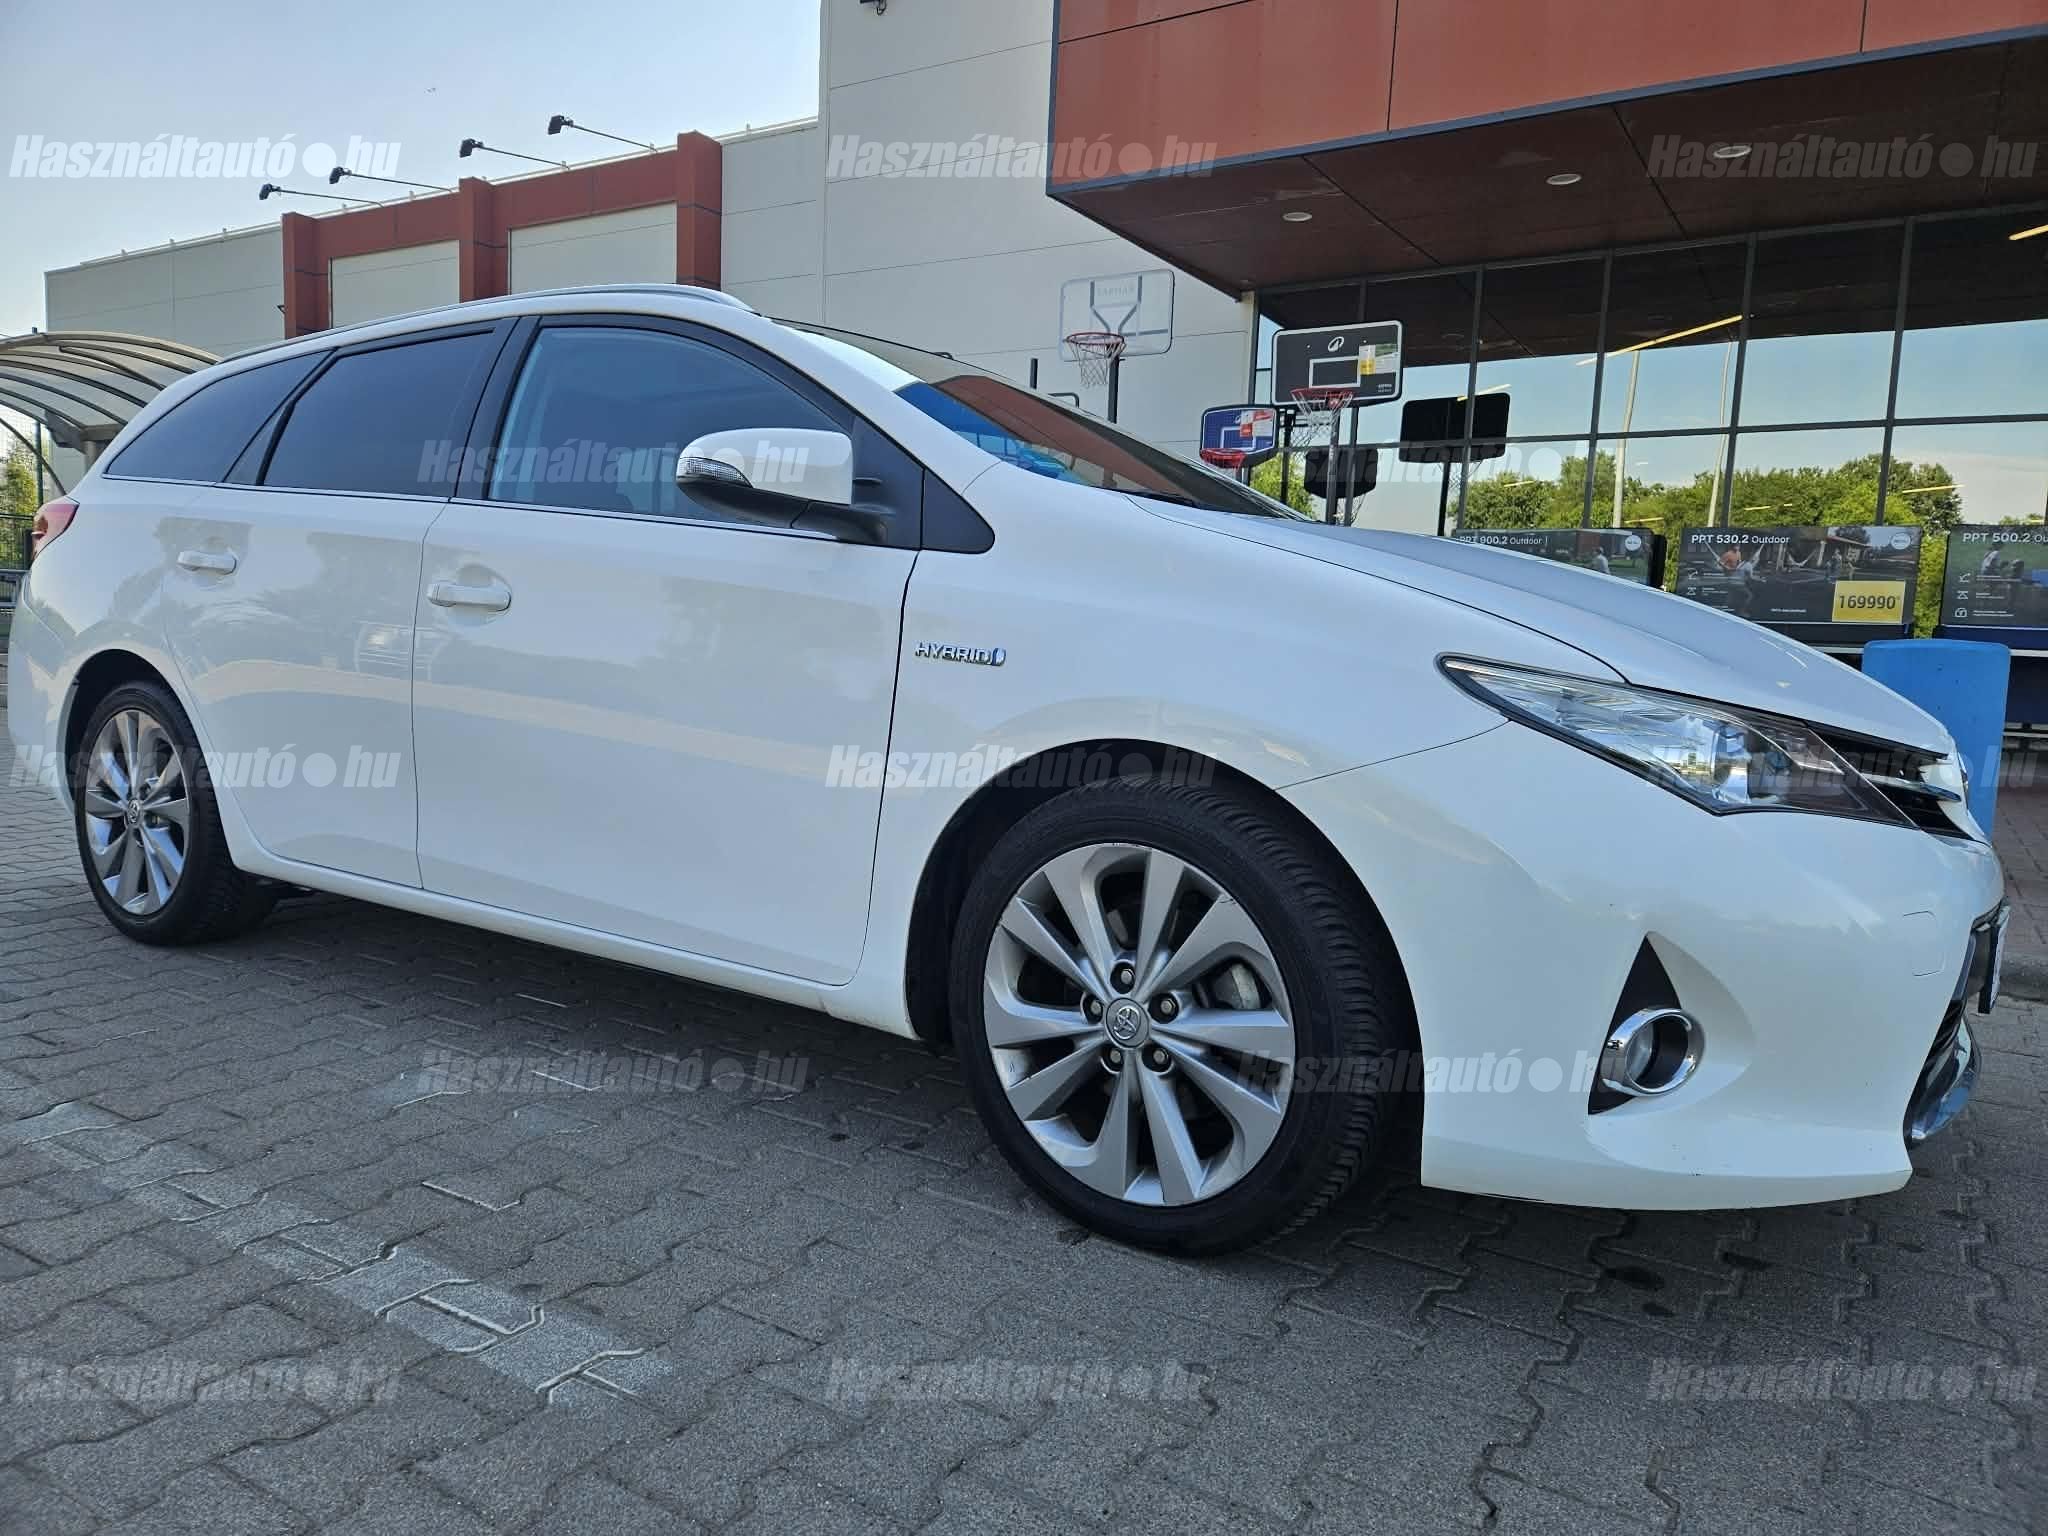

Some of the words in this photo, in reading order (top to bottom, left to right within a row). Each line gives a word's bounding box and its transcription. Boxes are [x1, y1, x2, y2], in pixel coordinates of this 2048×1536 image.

[1479, 535, 1508, 545] 900.2
[1691, 534, 1713, 544] PPT
[1716, 534, 1749, 544] 530.2
[1751, 535, 1791, 544] Outdoor
[1962, 533, 1989, 542] PPT
[1992, 532, 2031, 543] 500.2
[1839, 594, 1896, 610] 169990
[915, 641, 992, 665] HYBRID
